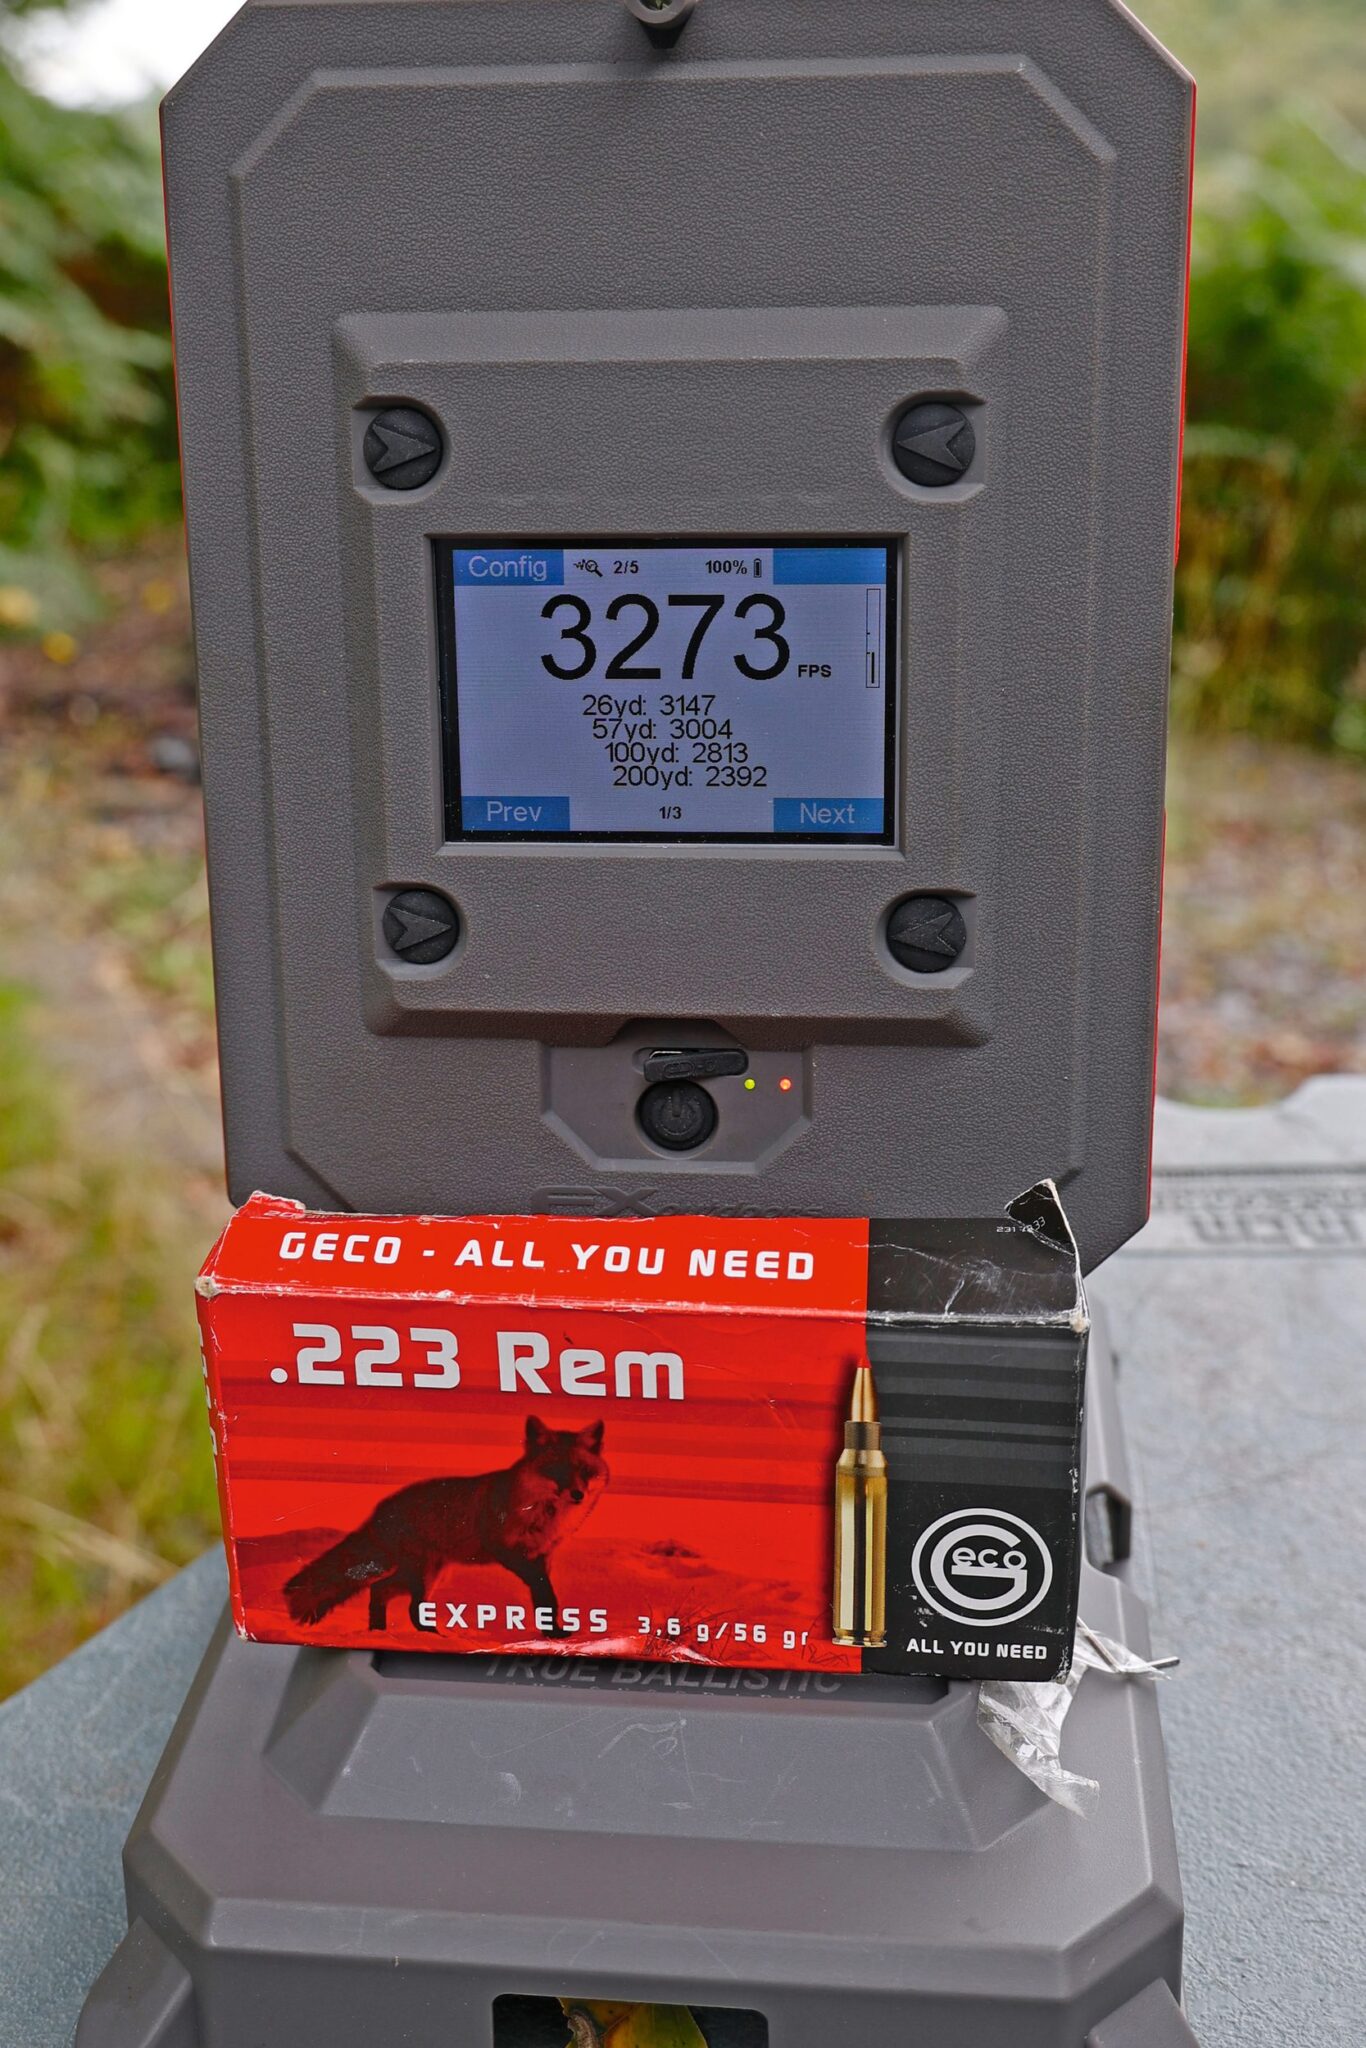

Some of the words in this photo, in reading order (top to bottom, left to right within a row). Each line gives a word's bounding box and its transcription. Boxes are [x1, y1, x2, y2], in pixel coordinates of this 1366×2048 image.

[468, 555, 547, 582] Config
[613, 560, 639, 574] 2/5
[705, 559, 748, 575] 100%
[540, 593, 790, 680] 3273
[797, 664, 832, 678] FPS
[582, 694, 647, 719] 26yd:
[659, 693, 716, 716] 3147
[592, 718, 657, 742] 57yd:
[669, 718, 733, 740] 3004
[605, 742, 679, 766] 100yd:
[692, 742, 749, 764] 2813
[613, 765, 693, 790] 200yd:
[706, 766, 767, 787] 2392
[487, 802, 542, 822] Prev
[659, 806, 682, 820] 1/3
[800, 802, 855, 825] Next
[279, 1231, 401, 1264] GECO
[453, 1239, 545, 1268] ALL
[570, 1243, 665, 1275] YOU
[688, 1248, 815, 1280] NEED
[270, 1322, 461, 1390] .223
[496, 1330, 685, 1400] Rem
[418, 1602, 608, 1633] EXPRESS
[638, 1616, 680, 1637] 3,6
[696, 1622, 767, 1643] g/56
[782, 1630, 809, 1650] gr
[906, 1638, 944, 1654] ALL
[950, 1640, 990, 1657] YOU
[996, 1643, 1048, 1660] NEED
